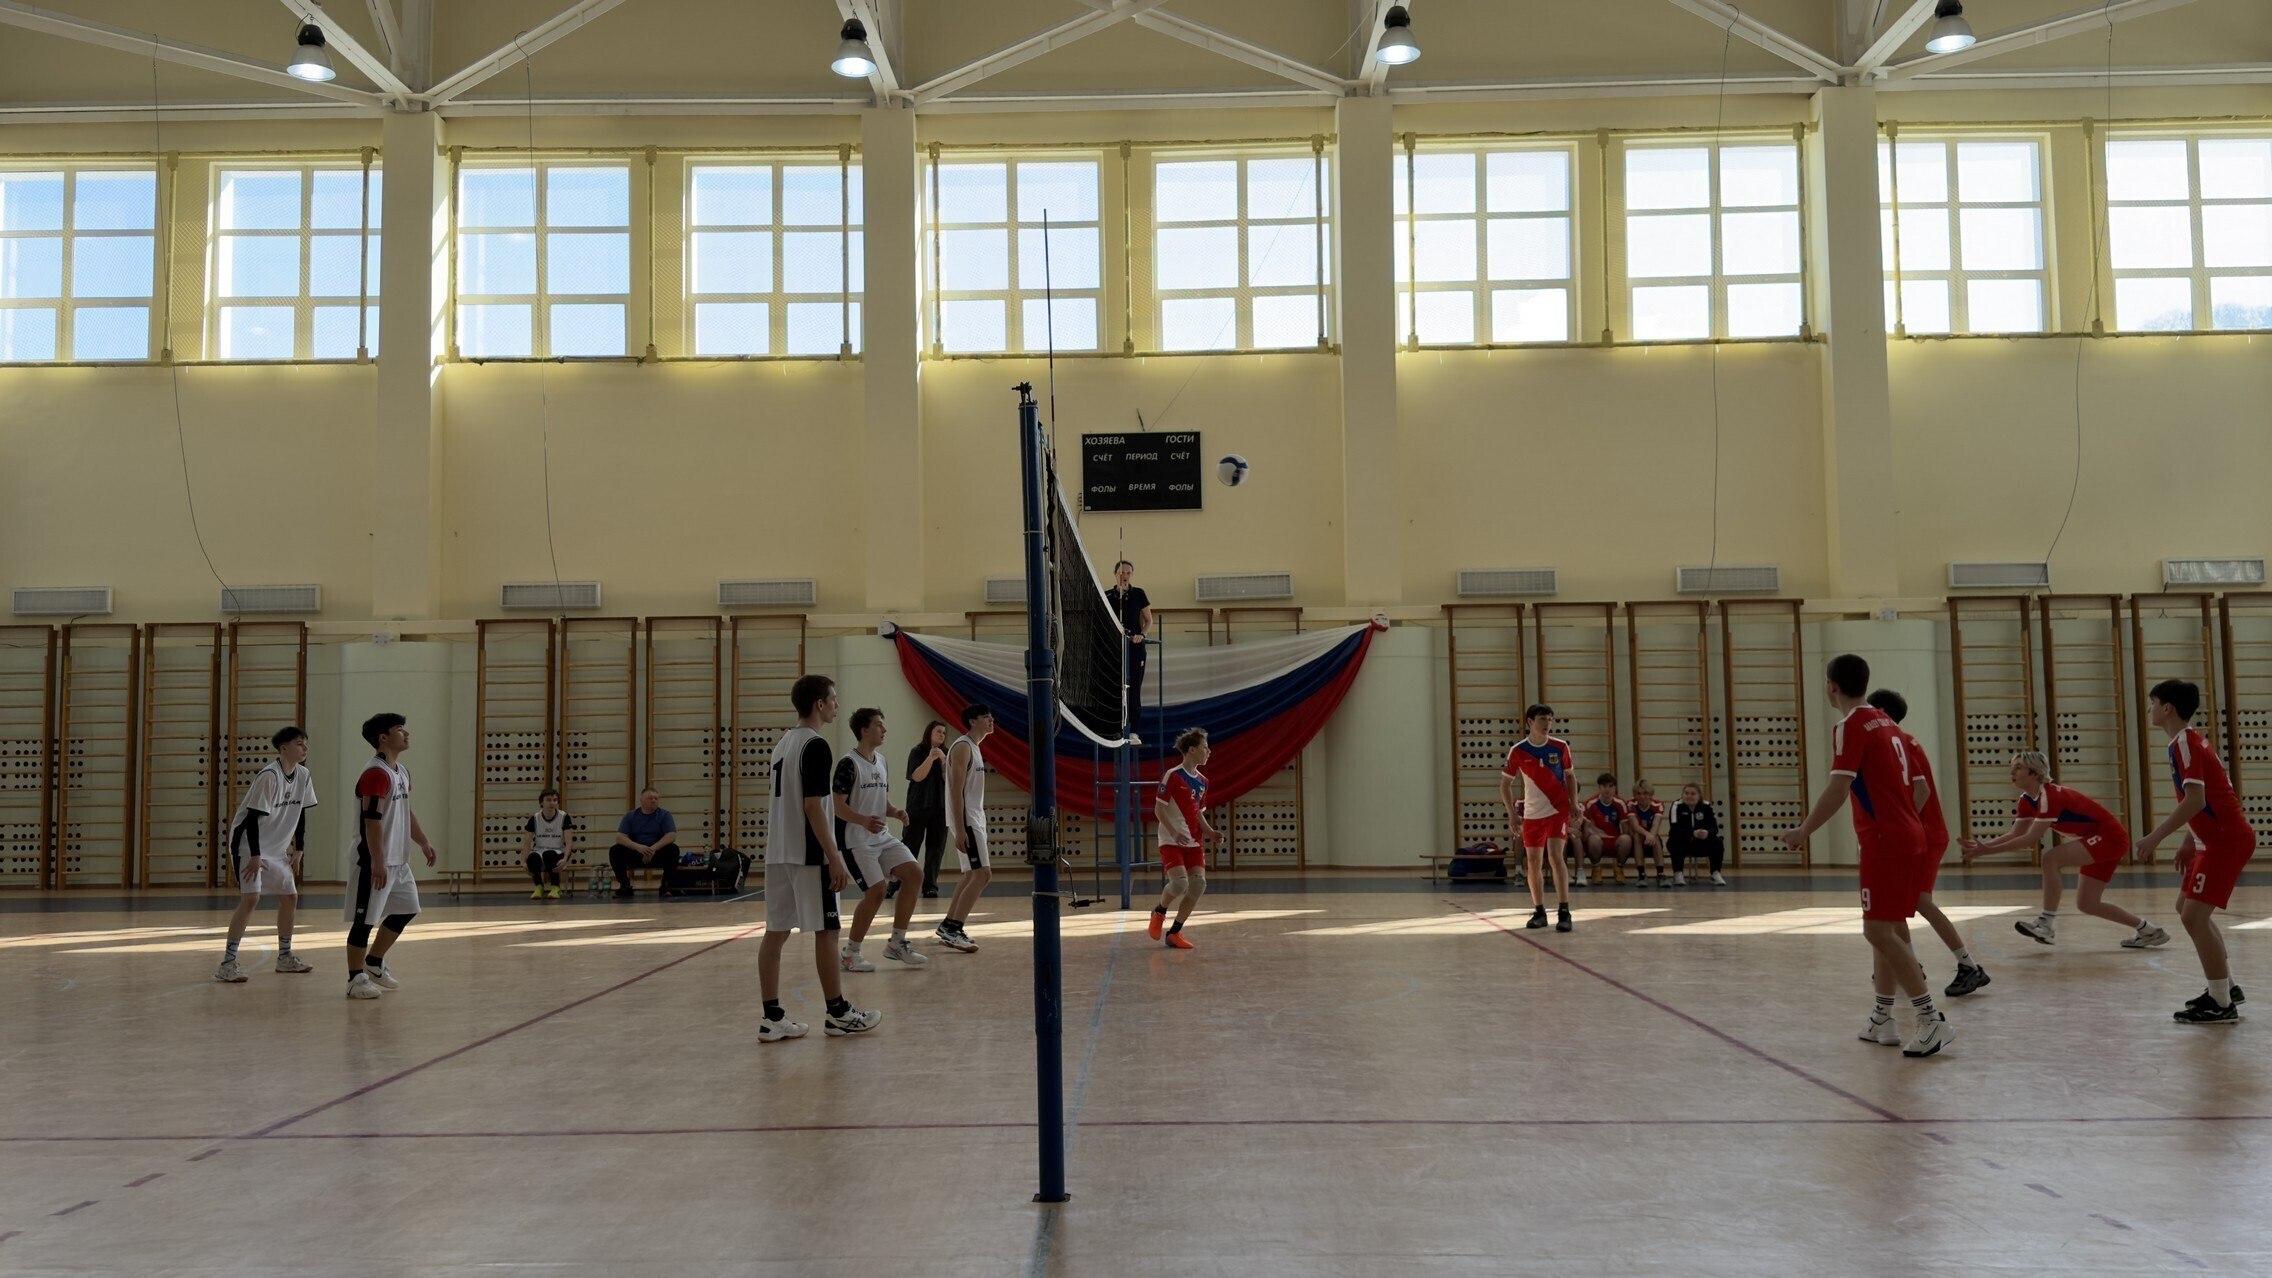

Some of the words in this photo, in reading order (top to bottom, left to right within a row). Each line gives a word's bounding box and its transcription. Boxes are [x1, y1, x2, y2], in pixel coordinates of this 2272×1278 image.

[1085, 436, 1125, 445] ХОЗЯЕВА
[1166, 435, 1194, 443] ГОСТИ
[1093, 453, 1112, 461] СЧЁТ
[1170, 452, 1190, 460] СЧЁТ
[1091, 485, 1116, 493] ФОЛЫ
[1128, 483, 1156, 491] ВРЕМЯ
[1168, 484, 1194, 492] ФОЛЫ
[1891, 736, 1910, 786] 9
[772, 757, 784, 797] 1
[2086, 835, 2102, 846] 6
[2192, 872, 2206, 894] 3
[1862, 888, 1871, 911] 9
